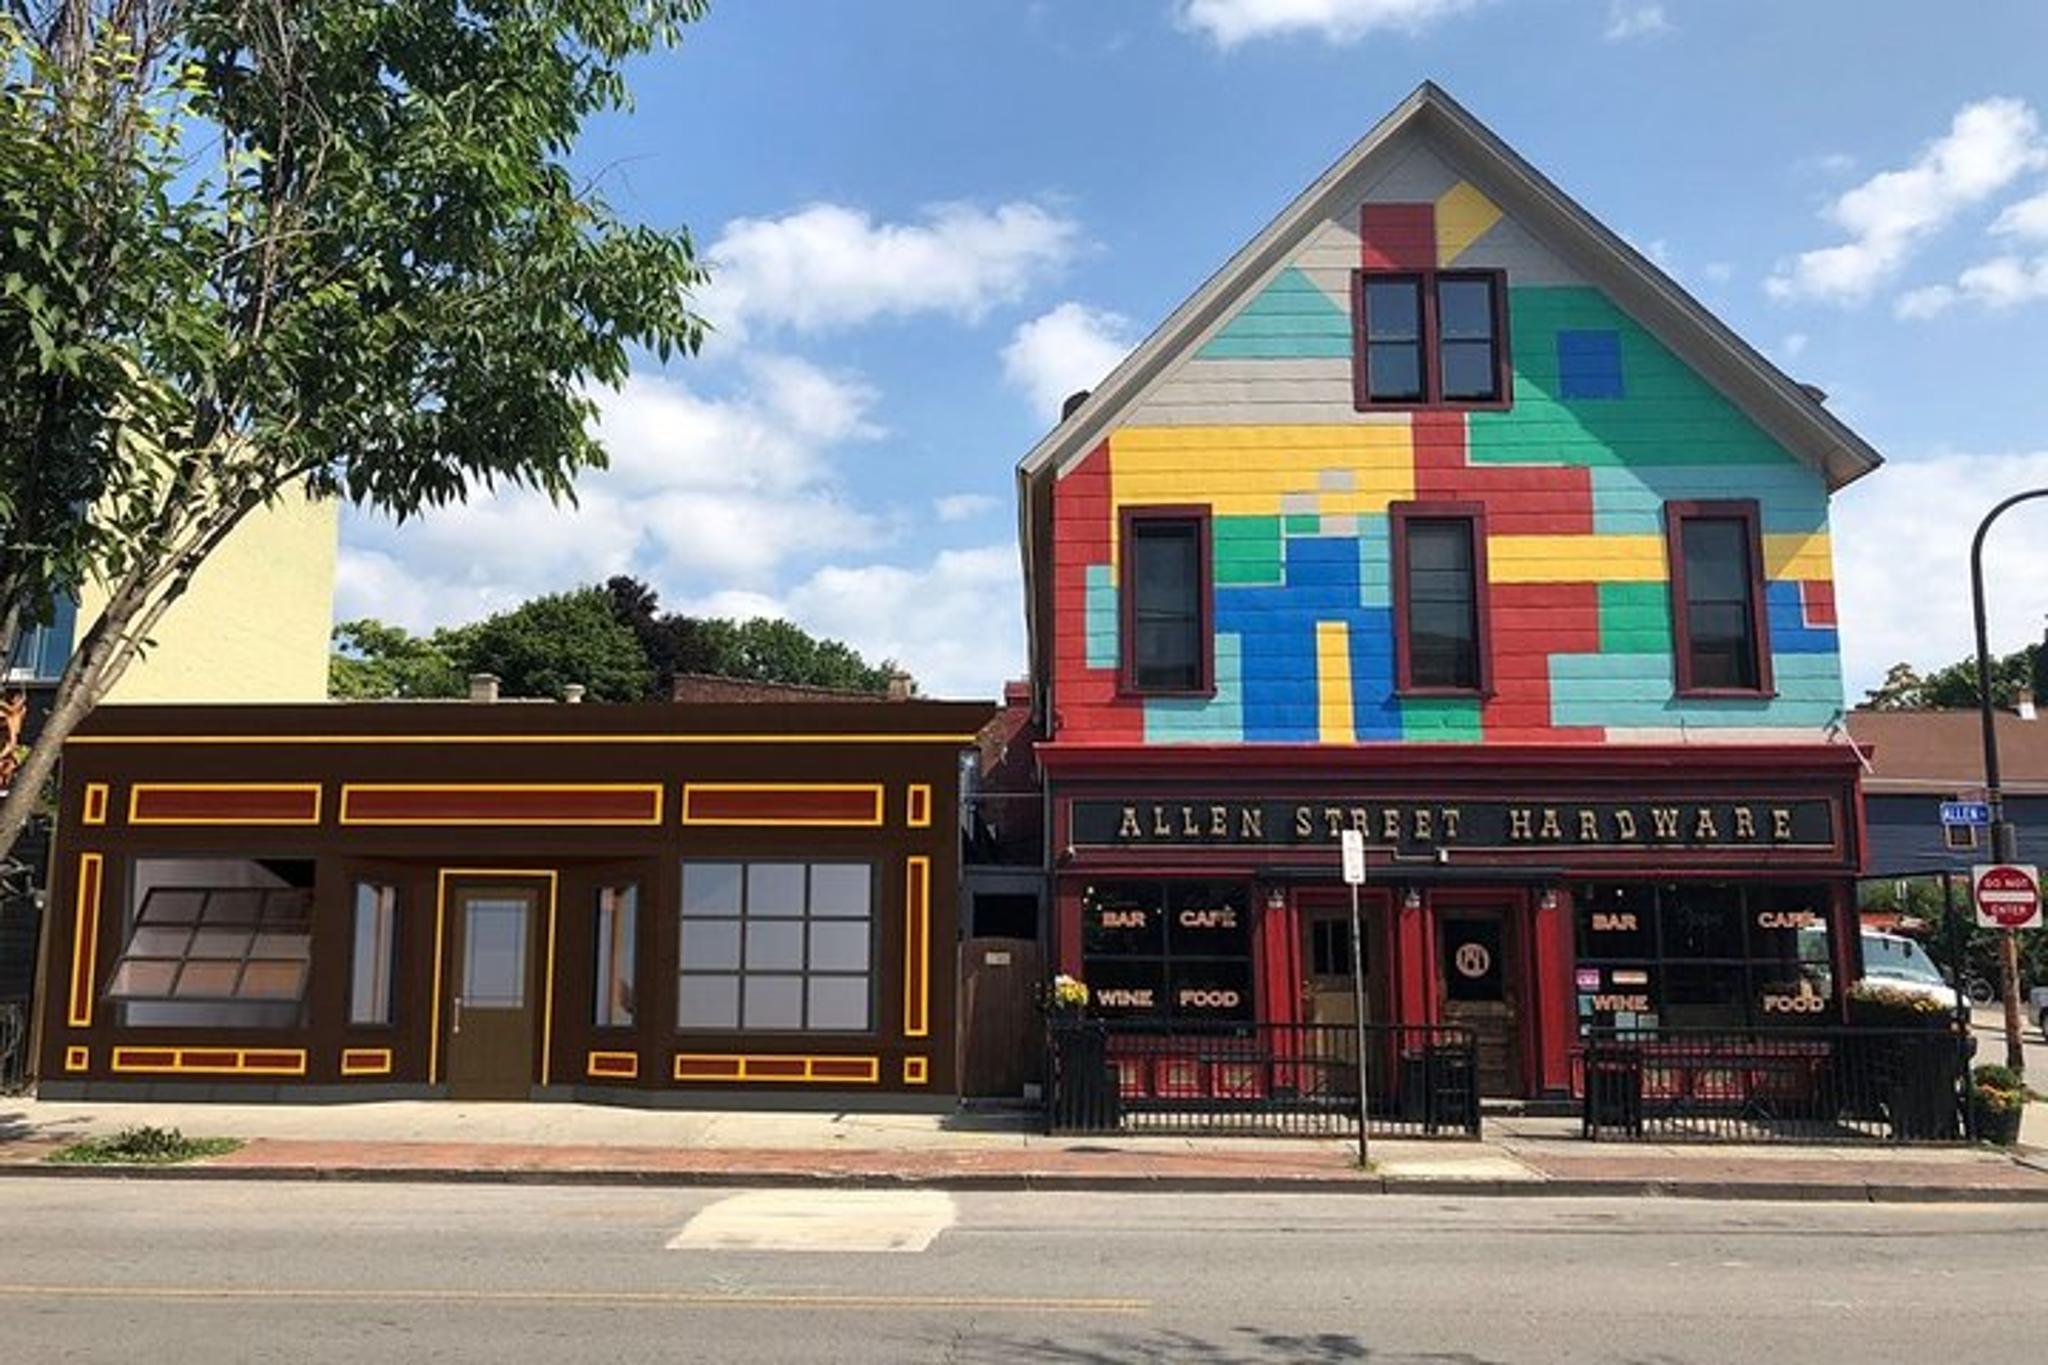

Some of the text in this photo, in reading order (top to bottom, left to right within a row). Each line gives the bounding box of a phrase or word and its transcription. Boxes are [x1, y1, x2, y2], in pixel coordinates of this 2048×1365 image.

[1943, 806, 1979, 820] ALLEN
[1119, 806, 1793, 840] ALLEN STREET HARDWARE
[1984, 878, 2029, 888] DO NOT
[1990, 904, 2027, 916] ENTER
[1102, 911, 1146, 928] BAR
[1592, 913, 1638, 931] BAR
[1097, 989, 1239, 1007] WINE FOOD
[1592, 994, 1825, 1013] WINE FOOD
